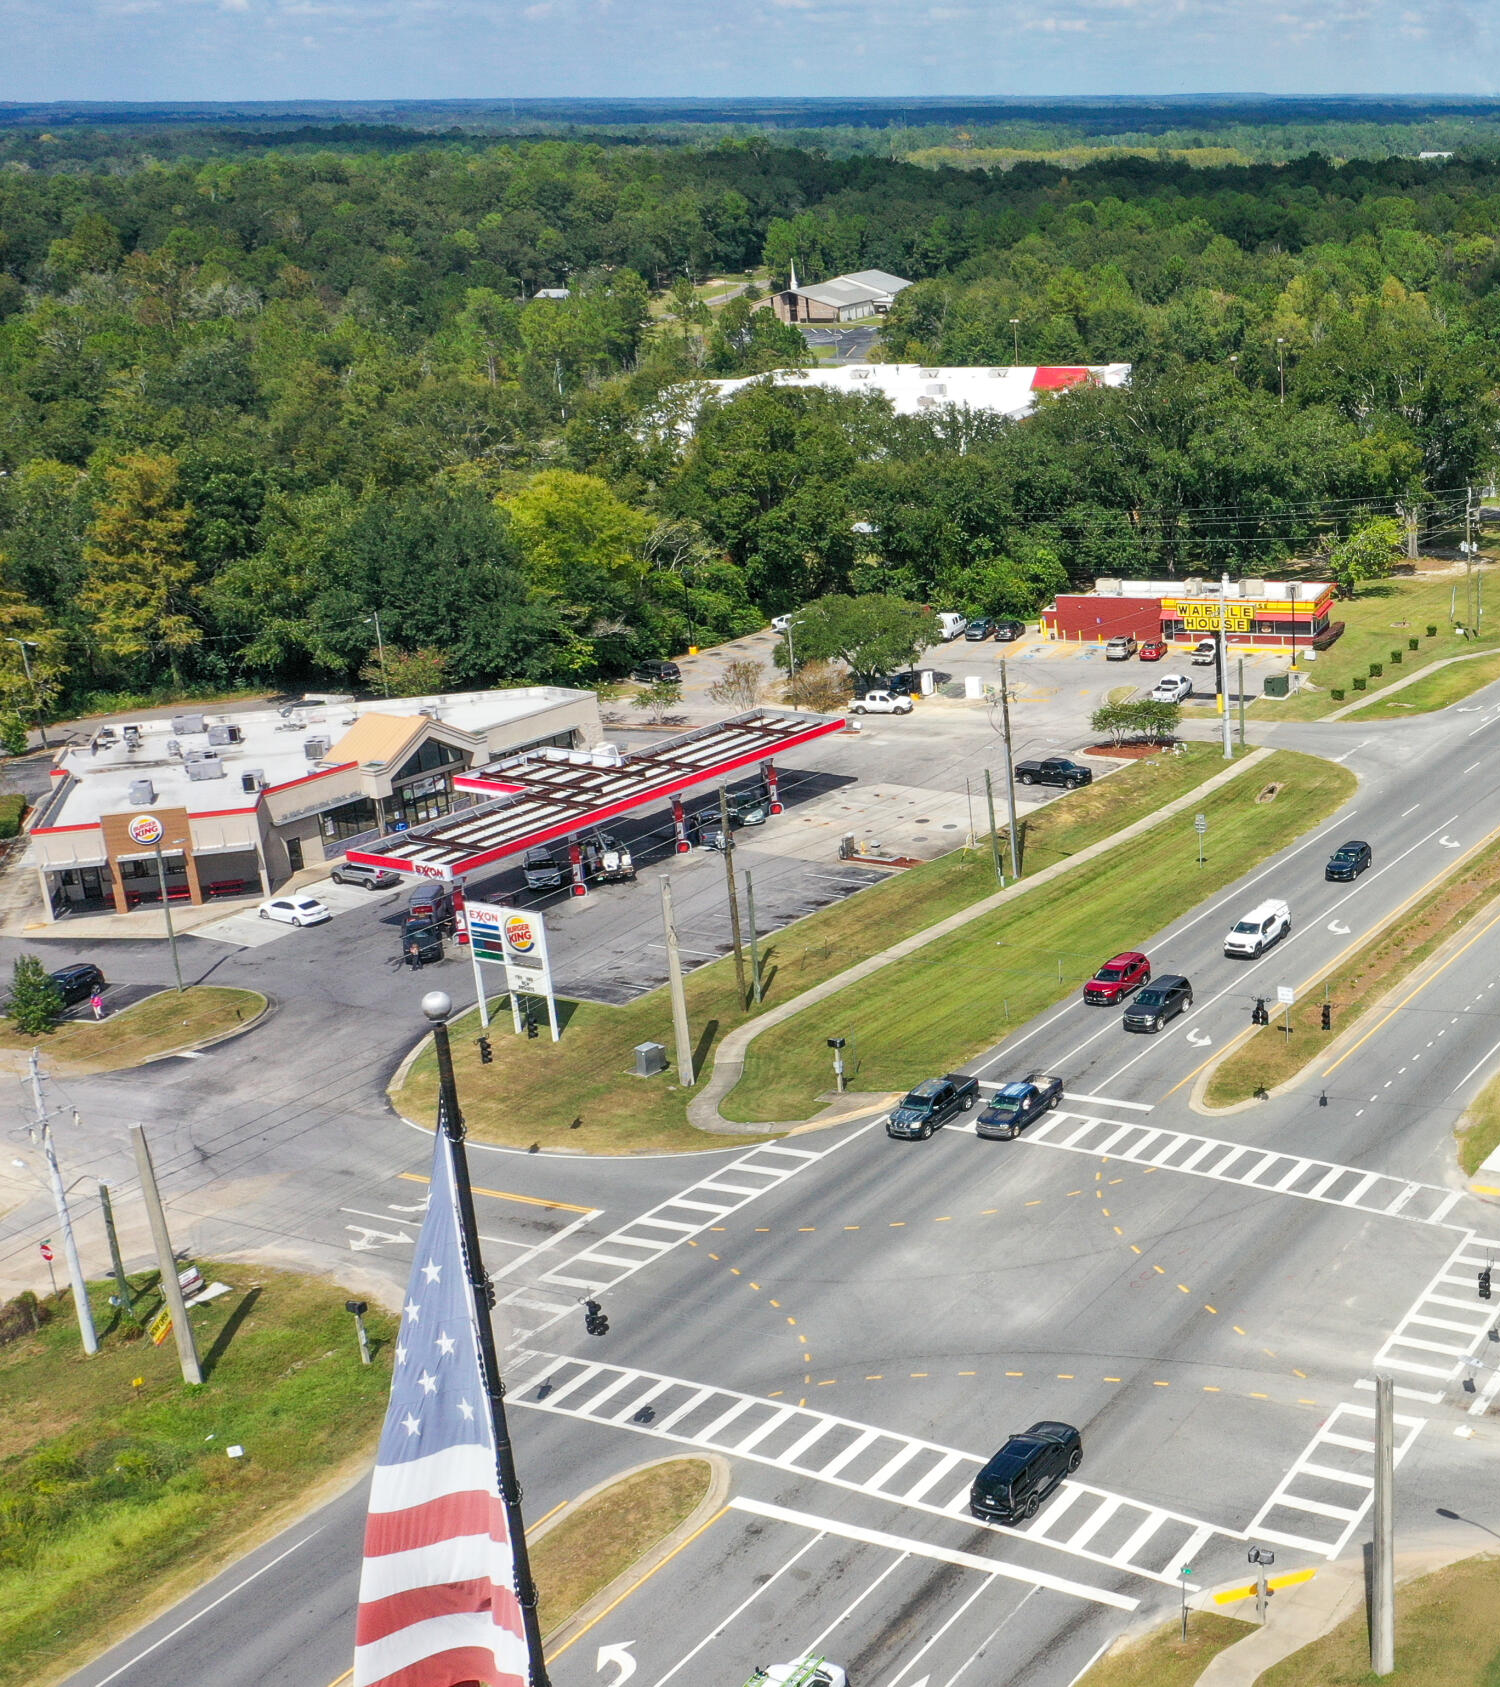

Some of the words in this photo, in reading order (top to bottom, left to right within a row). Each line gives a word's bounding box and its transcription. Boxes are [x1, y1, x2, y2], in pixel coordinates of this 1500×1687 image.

[1186, 618, 1245, 630] HOUSE
[133, 820, 157, 832] BURGER
[135, 826, 159, 839] KING
[415, 864, 444, 878] EXXON
[469, 910, 498, 923] EXXON
[506, 923, 529, 934] BURGER
[508, 930, 532, 943] KING
